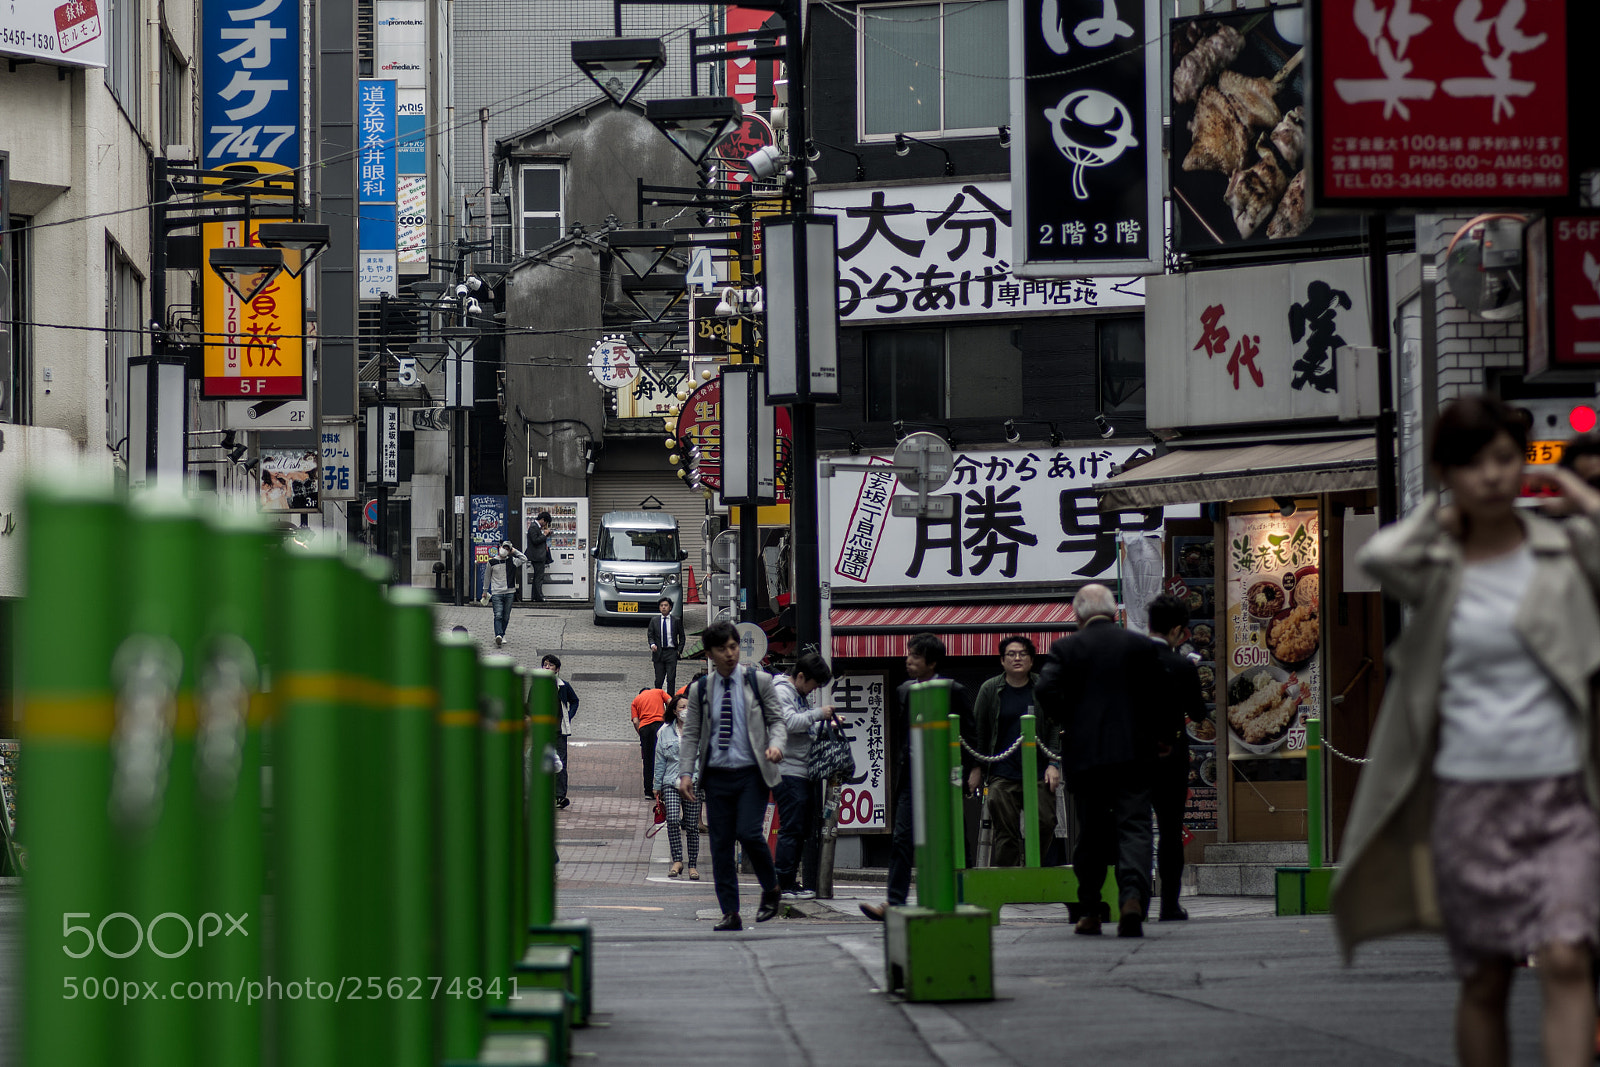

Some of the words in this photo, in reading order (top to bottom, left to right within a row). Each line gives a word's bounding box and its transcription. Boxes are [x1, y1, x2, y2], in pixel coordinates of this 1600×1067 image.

[62, 20, 97, 46] ホルモン
[207, 126, 296, 158] 747
[363, 86, 386, 197] 道玄坂糸井眼科
[1331, 155, 1394, 171] 営業時間
[1333, 174, 1497, 189] TEL.03-3496-0688
[1502, 174, 1563, 189] 年中無休
[838, 185, 1012, 261] 大分
[686, 249, 717, 293] 4
[998, 279, 1071, 306] 専門店
[1192, 303, 1265, 391] 名代
[399, 358, 417, 386] 5
[601, 348, 611, 381] やまがた
[290, 410, 306, 422] 2F
[322, 465, 350, 491] 子店
[476, 531, 501, 541] BOSS
[1233, 647, 1270, 666] 650円
[866, 682, 884, 788] 何時でも何杯飲んでも
[1288, 729, 1305, 749] 57
